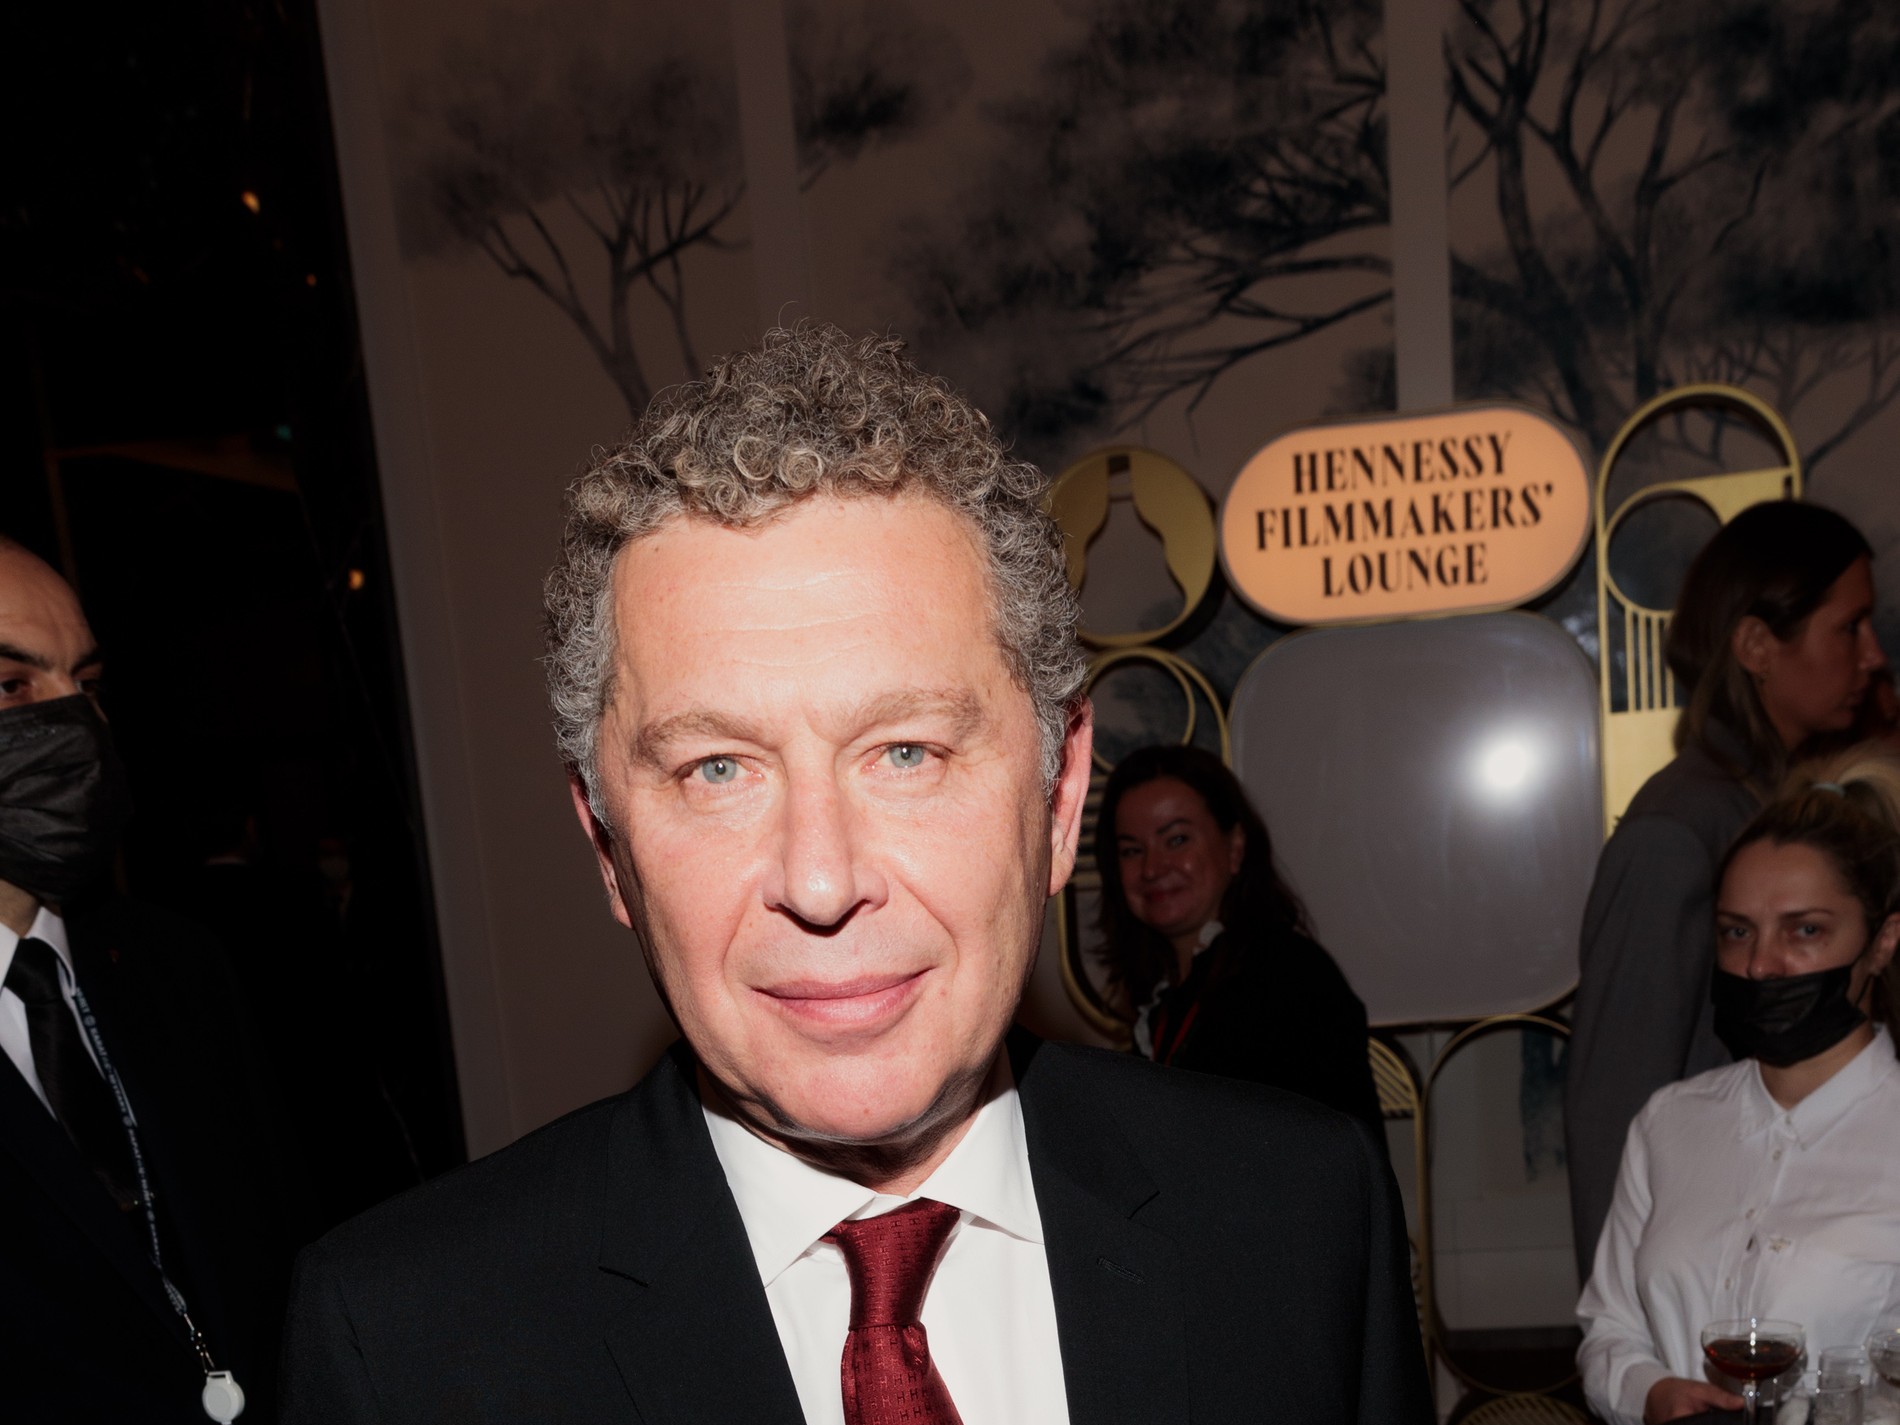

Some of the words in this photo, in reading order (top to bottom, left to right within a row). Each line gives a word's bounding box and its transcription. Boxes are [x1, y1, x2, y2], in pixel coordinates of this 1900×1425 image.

[1293, 431, 1512, 495] HENNESSY
[1255, 482, 1554, 552] FILMMAKERS'
[1322, 542, 1489, 599] LOUNGE
